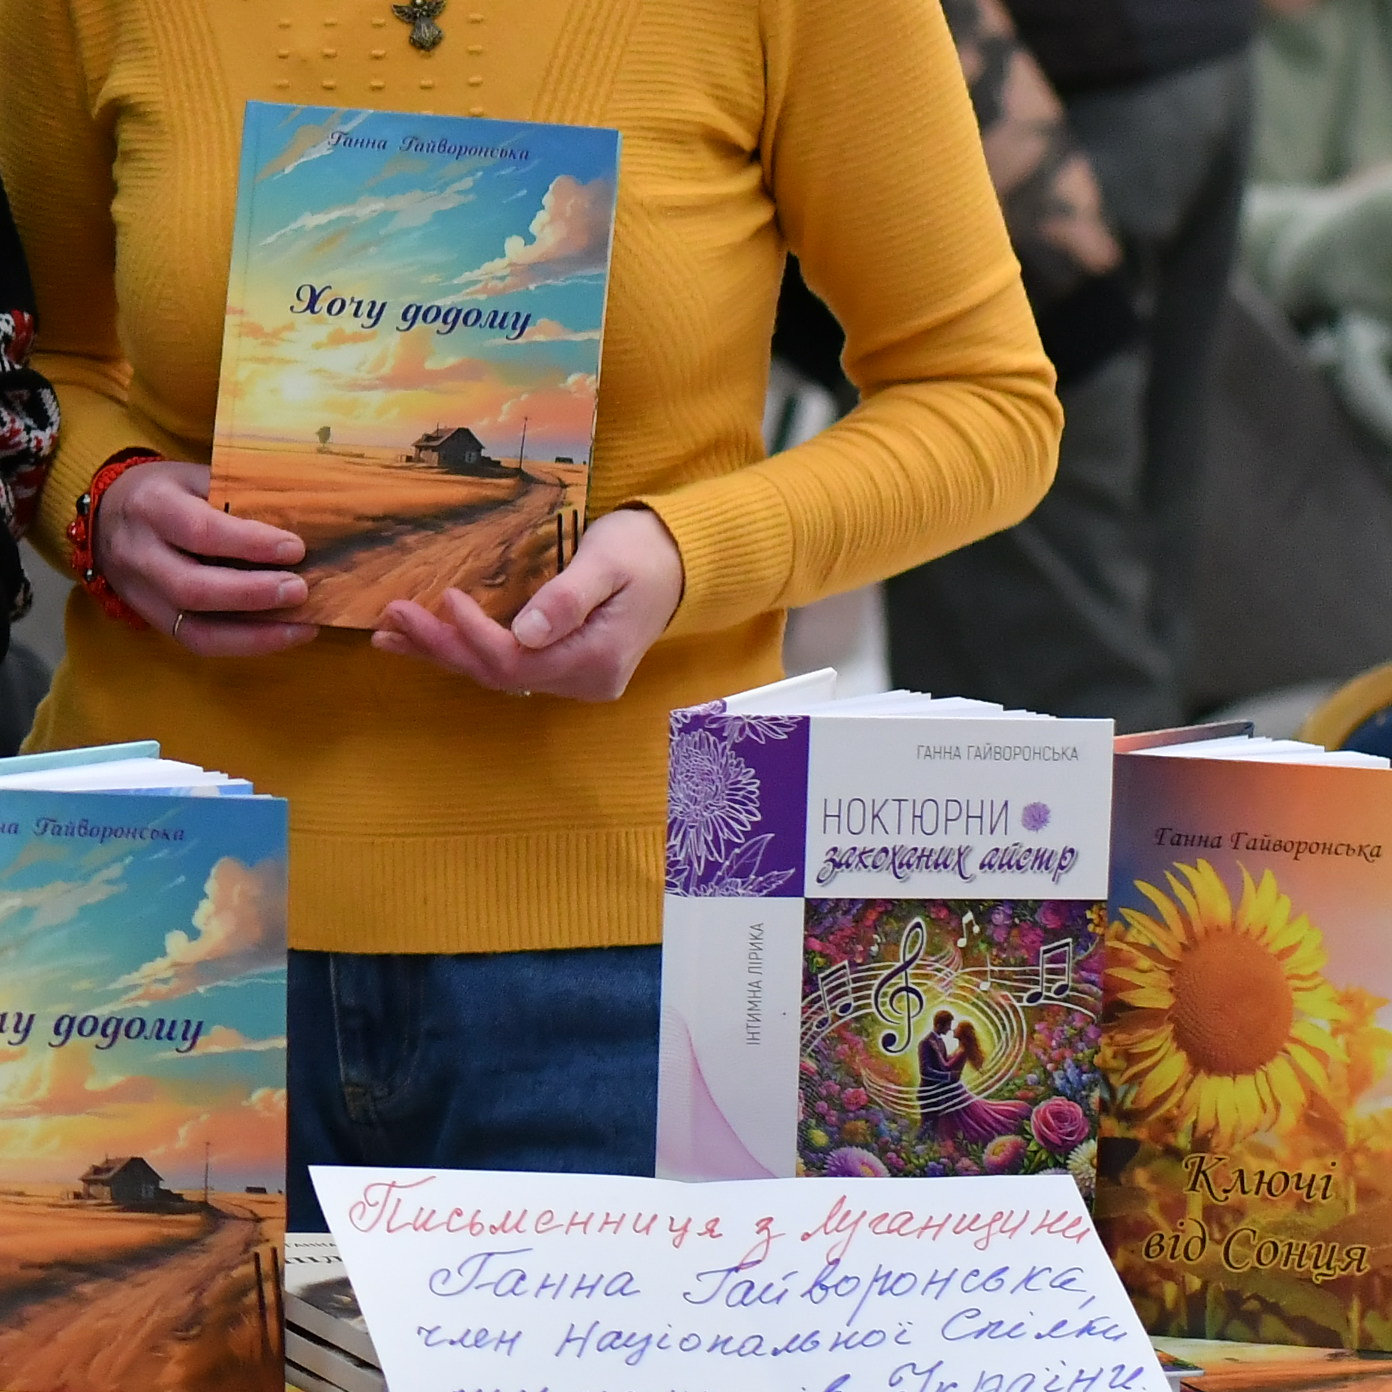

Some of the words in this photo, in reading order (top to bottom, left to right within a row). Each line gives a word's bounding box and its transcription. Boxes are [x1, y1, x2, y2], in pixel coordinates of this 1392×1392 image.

[328, 131, 388, 150] Ганна
[399, 136, 530, 160] Гайворонська
[289, 284, 386, 331] Хочу
[396, 301, 532, 340] додому
[916, 745, 962, 761] ГАННА
[966, 743, 1080, 762] ГАЙВОРОНСЬКА
[33, 816, 185, 844] Гайворонська
[822, 797, 1010, 836] НОКТЮРНИ
[816, 842, 975, 884] закоханих
[979, 841, 1079, 884] айстр
[1154, 827, 1222, 850] Ганна
[1230, 831, 1383, 863] Гайворонська
[748, 922, 764, 975] ЛІРИКА
[48, 1013, 204, 1054] додому
[746, 980, 762, 1045] ІНТИМНА
[1183, 1153, 1337, 1203] Ключі
[349, 1176, 724, 1248] Письменниця
[737, 1215, 786, 1270] з
[428, 1248, 641, 1301] Ганна
[1143, 1218, 1208, 1262] від
[1222, 1226, 1370, 1283] Сонця
[417, 1323, 523, 1357] член
[556, 1320, 913, 1366] Національної
[941, 1307, 1129, 1343] Спілки
